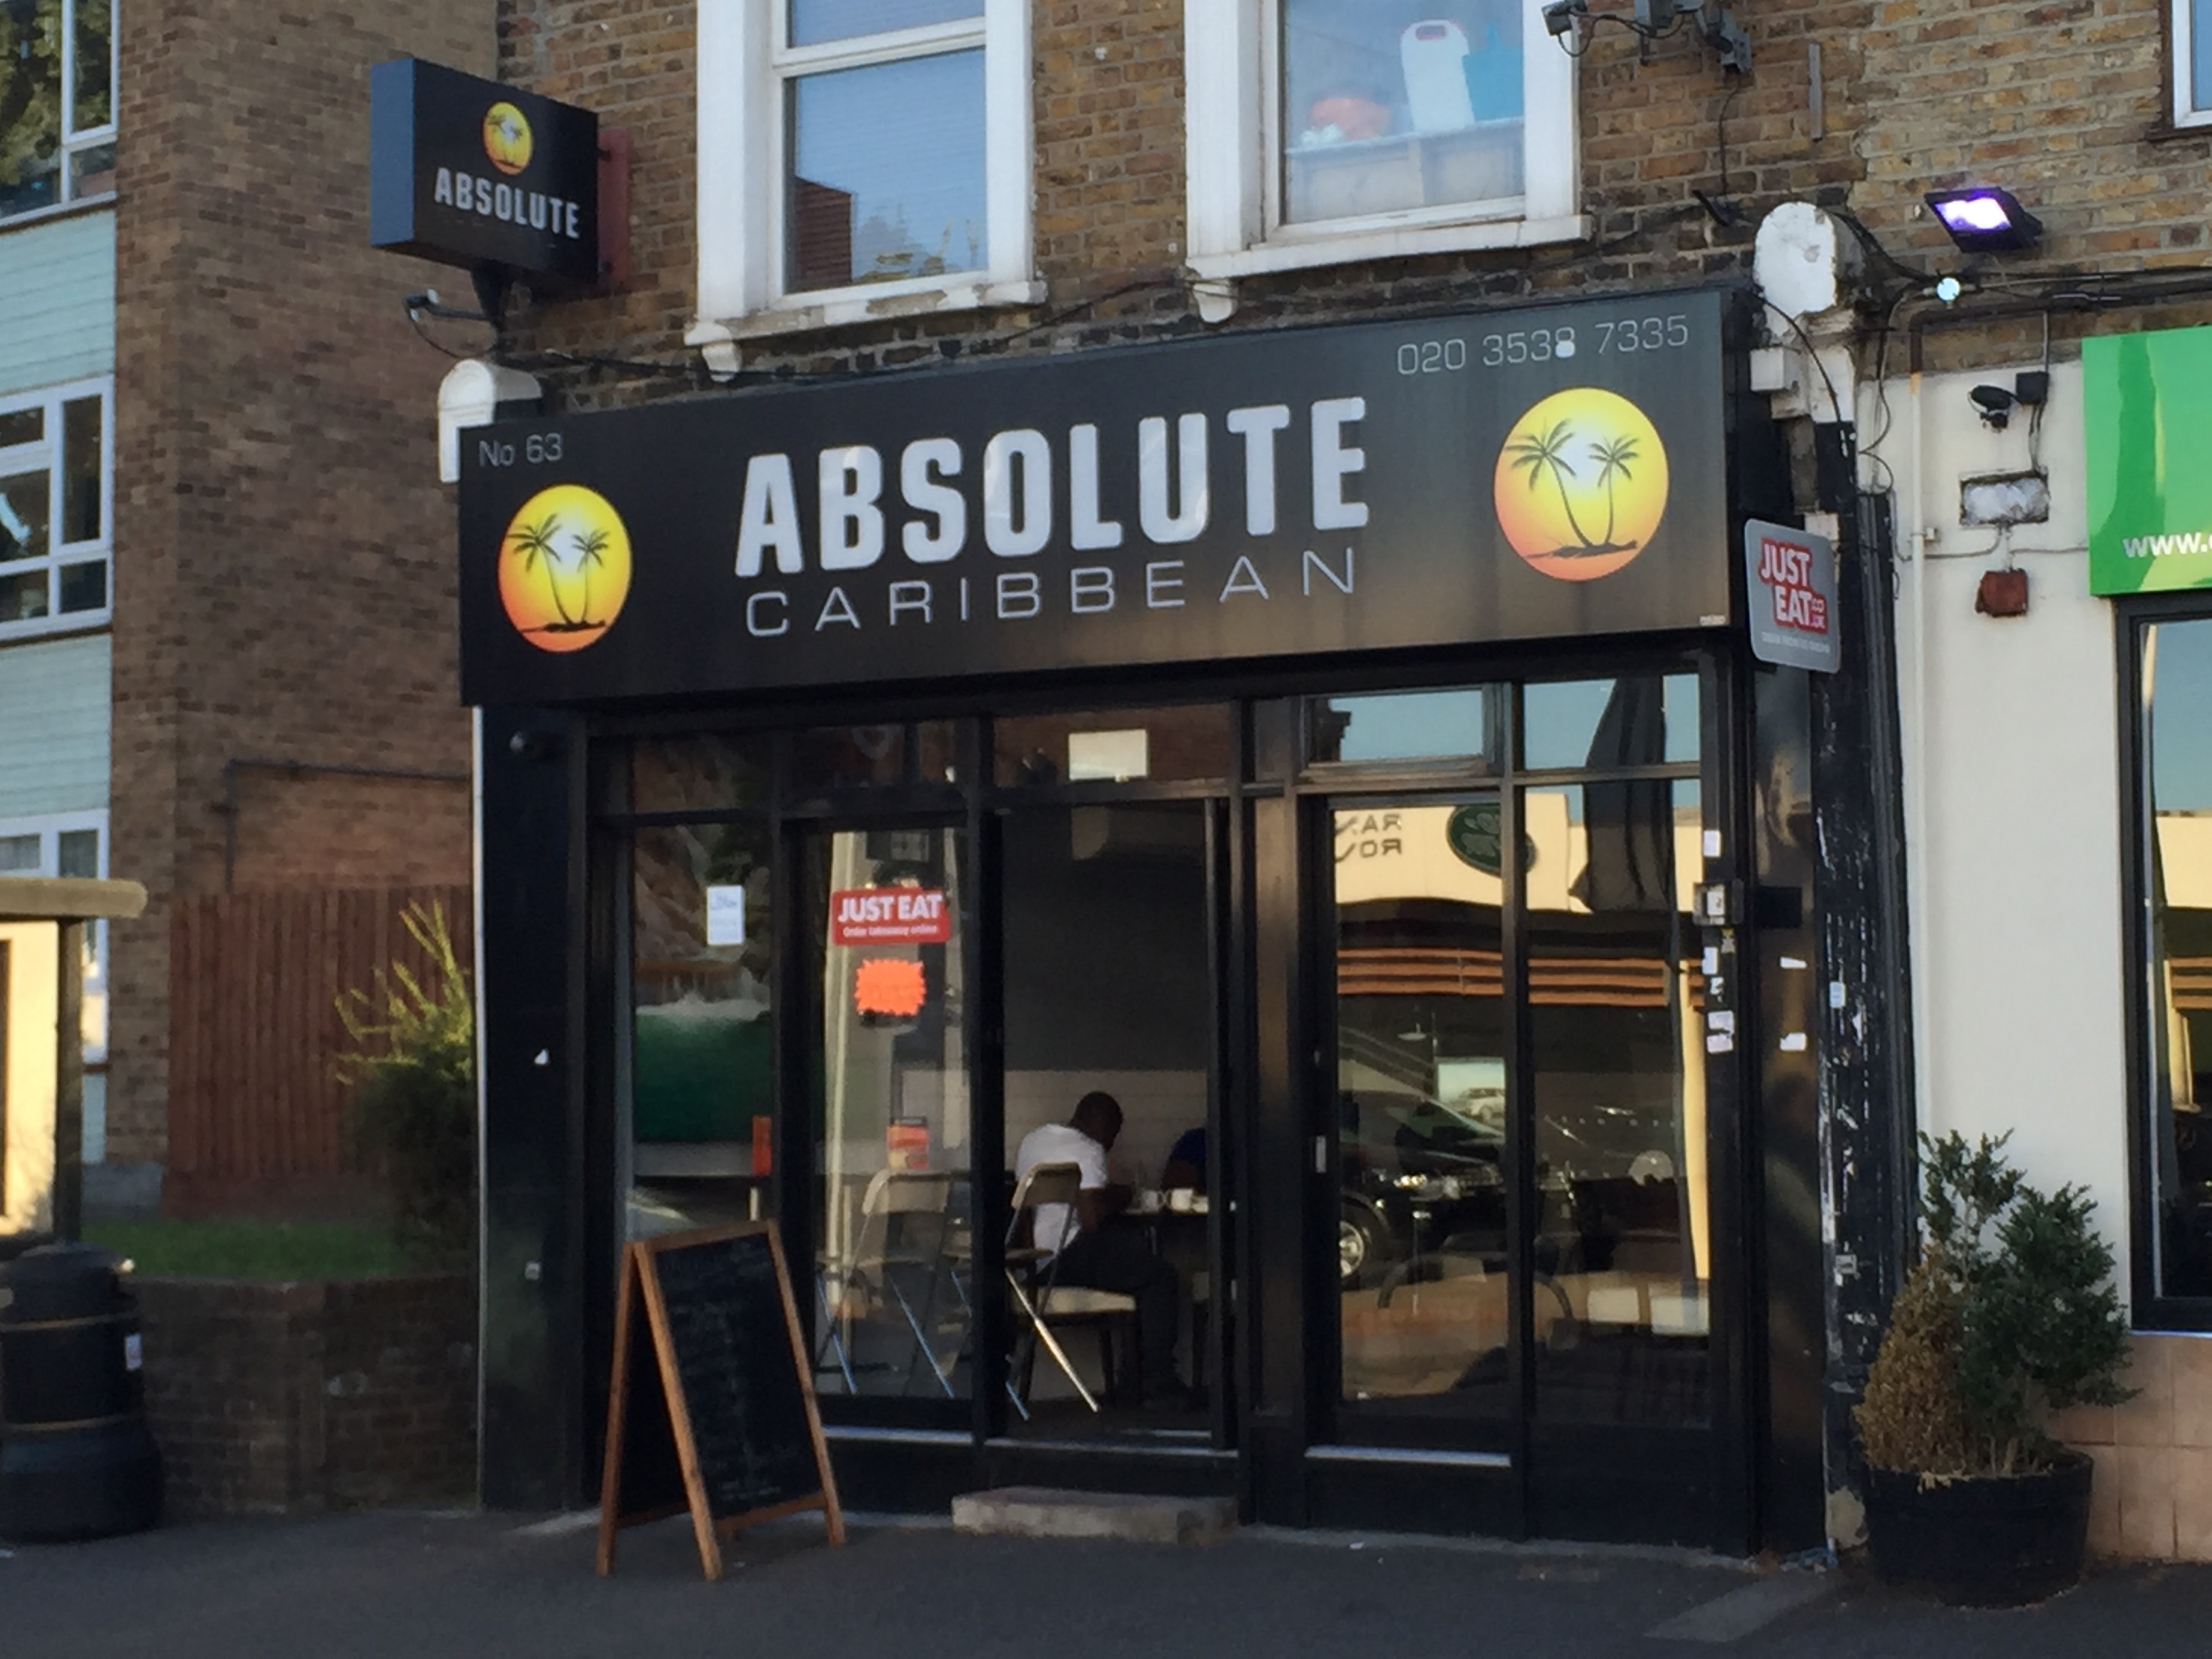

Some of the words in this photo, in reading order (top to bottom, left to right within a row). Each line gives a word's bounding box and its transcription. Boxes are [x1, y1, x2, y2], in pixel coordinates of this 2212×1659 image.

[434, 167, 580, 239] ABSOLUTE
[1397, 338, 1467, 375] 020
[1482, 326, 1576, 366] 3538
[1594, 314, 1689, 354] 7335
[479, 440, 514, 467] No
[526, 432, 562, 464] 63
[735, 396, 1370, 578] ABSOLUTE
[746, 547, 1355, 636] CARIBBEAN
[1761, 543, 1810, 588] JUST
[1775, 585, 1813, 626] EAT
[837, 896, 895, 923] JUST
[897, 893, 943, 920] EAT
